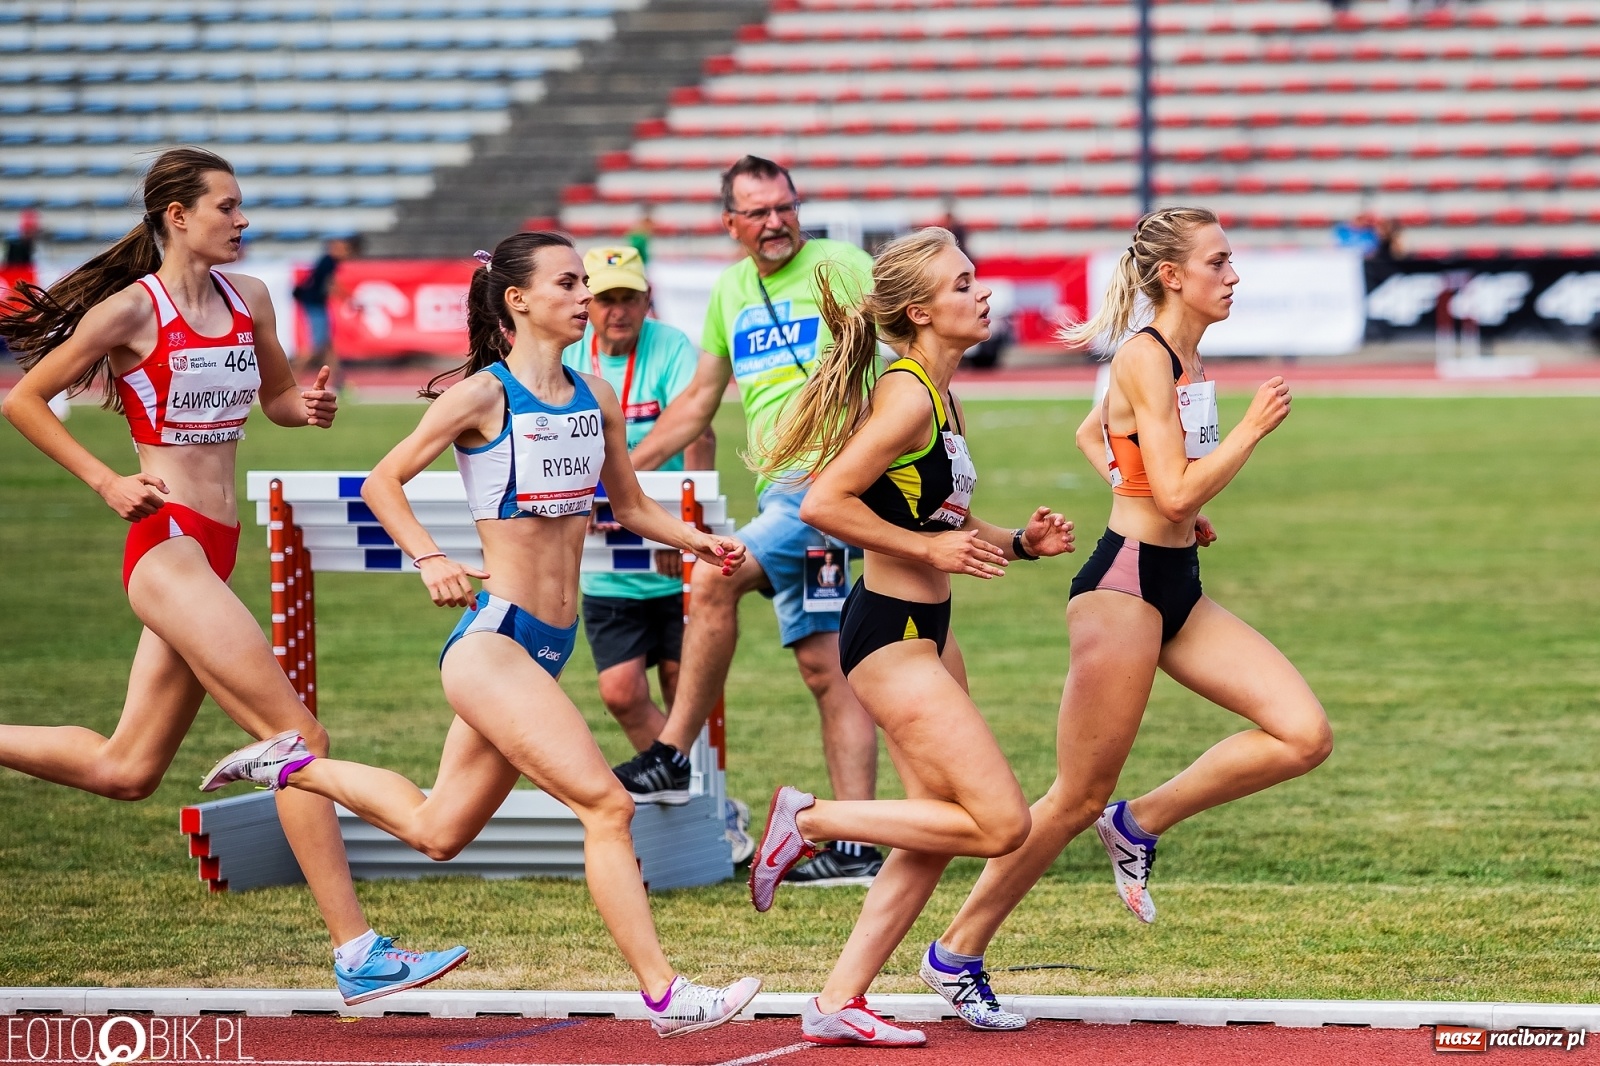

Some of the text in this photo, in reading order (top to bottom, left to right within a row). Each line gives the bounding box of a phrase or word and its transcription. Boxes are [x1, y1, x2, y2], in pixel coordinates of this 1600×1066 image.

[1447, 271, 1533, 326] 4F
[747, 322, 801, 354] TEAM
[224, 350, 256, 372] 464
[172, 389, 256, 409] ŁAWRUKAJTIS
[567, 414, 599, 438] 200
[175, 431, 226, 444] RACIBÓRZ
[543, 456, 591, 477] RYBAK
[531, 500, 575, 515] RACIBÓRZ
